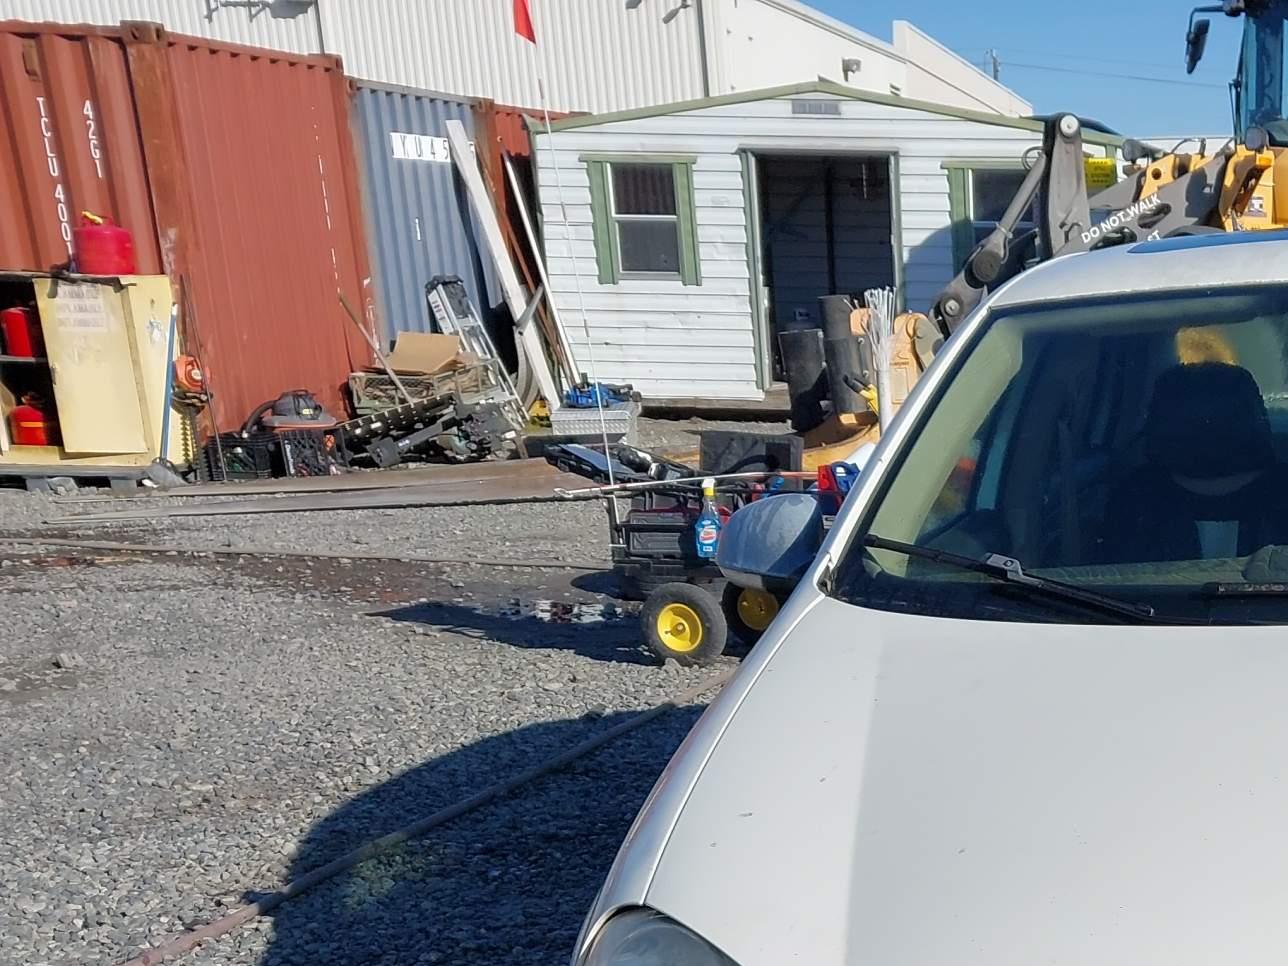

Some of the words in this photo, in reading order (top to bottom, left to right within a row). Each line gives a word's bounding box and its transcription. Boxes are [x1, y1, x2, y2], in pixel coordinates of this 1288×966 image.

[36, 96, 59, 177] TCLU
[83, 99, 103, 179] 42G1
[1081, 226, 1100, 243] DO
[1100, 212, 1125, 232] NOT
[1126, 193, 1161, 217] WALK
